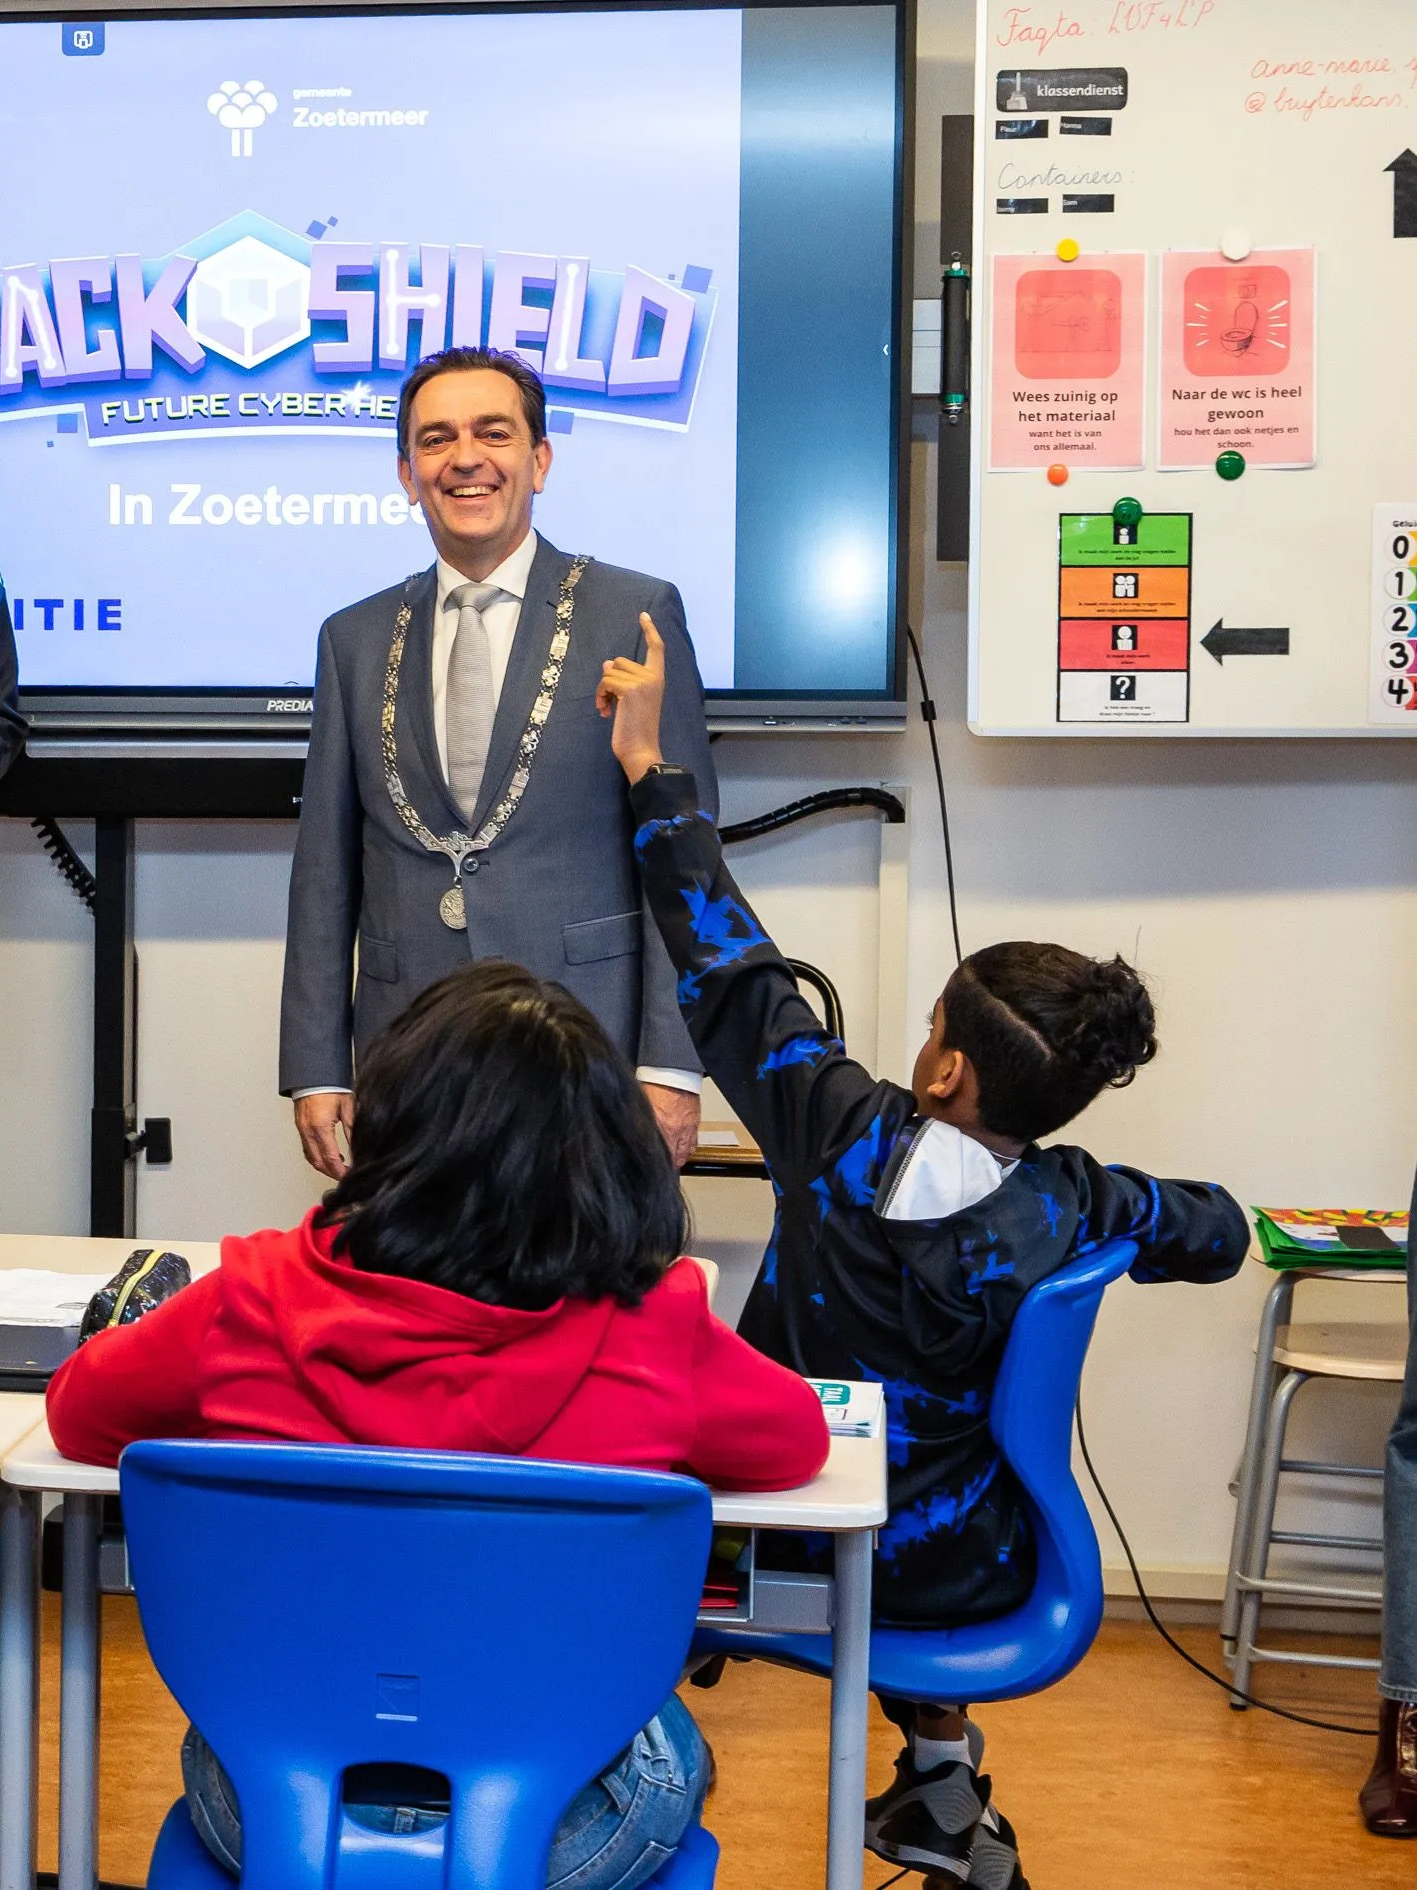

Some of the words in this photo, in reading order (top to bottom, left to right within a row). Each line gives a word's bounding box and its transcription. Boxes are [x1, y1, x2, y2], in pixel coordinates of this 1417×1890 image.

[292, 87, 352, 99] gemeente
[1037, 84, 1124, 97] klassendienst
[292, 106, 430, 128] Zoetermeer
[307, 240, 697, 397] SHIELD
[1012, 391, 1050, 403] Wees
[1054, 390, 1097, 406] zuinig
[1100, 392, 1119, 407] op
[1172, 388, 1206, 402] Naar
[1210, 387, 1228, 401] de
[1231, 389, 1252, 400] wc
[1255, 387, 1267, 400] is
[1271, 386, 1303, 399] heel
[102, 397, 228, 426] FUTURE
[237, 393, 346, 417] CYBER
[1018, 410, 1042, 423] het
[1046, 409, 1116, 423] materiaal
[1207, 409, 1265, 423] gewoon
[1029, 430, 1054, 438] want
[1056, 429, 1071, 438] het
[1073, 429, 1082, 438] is
[1174, 428, 1192, 436] hou
[1195, 427, 1210, 436] het
[1213, 427, 1231, 436] dan
[1233, 426, 1252, 435] ook
[1254, 426, 1285, 437] netjes
[1033, 443, 1051, 451] ons
[1053, 441, 1097, 451] allemaal.
[1217, 440, 1255, 448] schoon.
[108, 484, 154, 525] In
[169, 482, 435, 527] Zoeterme
[1392, 535, 1409, 560] 0
[1394, 571, 1404, 596] 1
[14, 598, 121, 631] ITIE
[1391, 606, 1409, 632] 2
[1389, 642, 1409, 669] 3
[1388, 679, 1409, 704] 4
